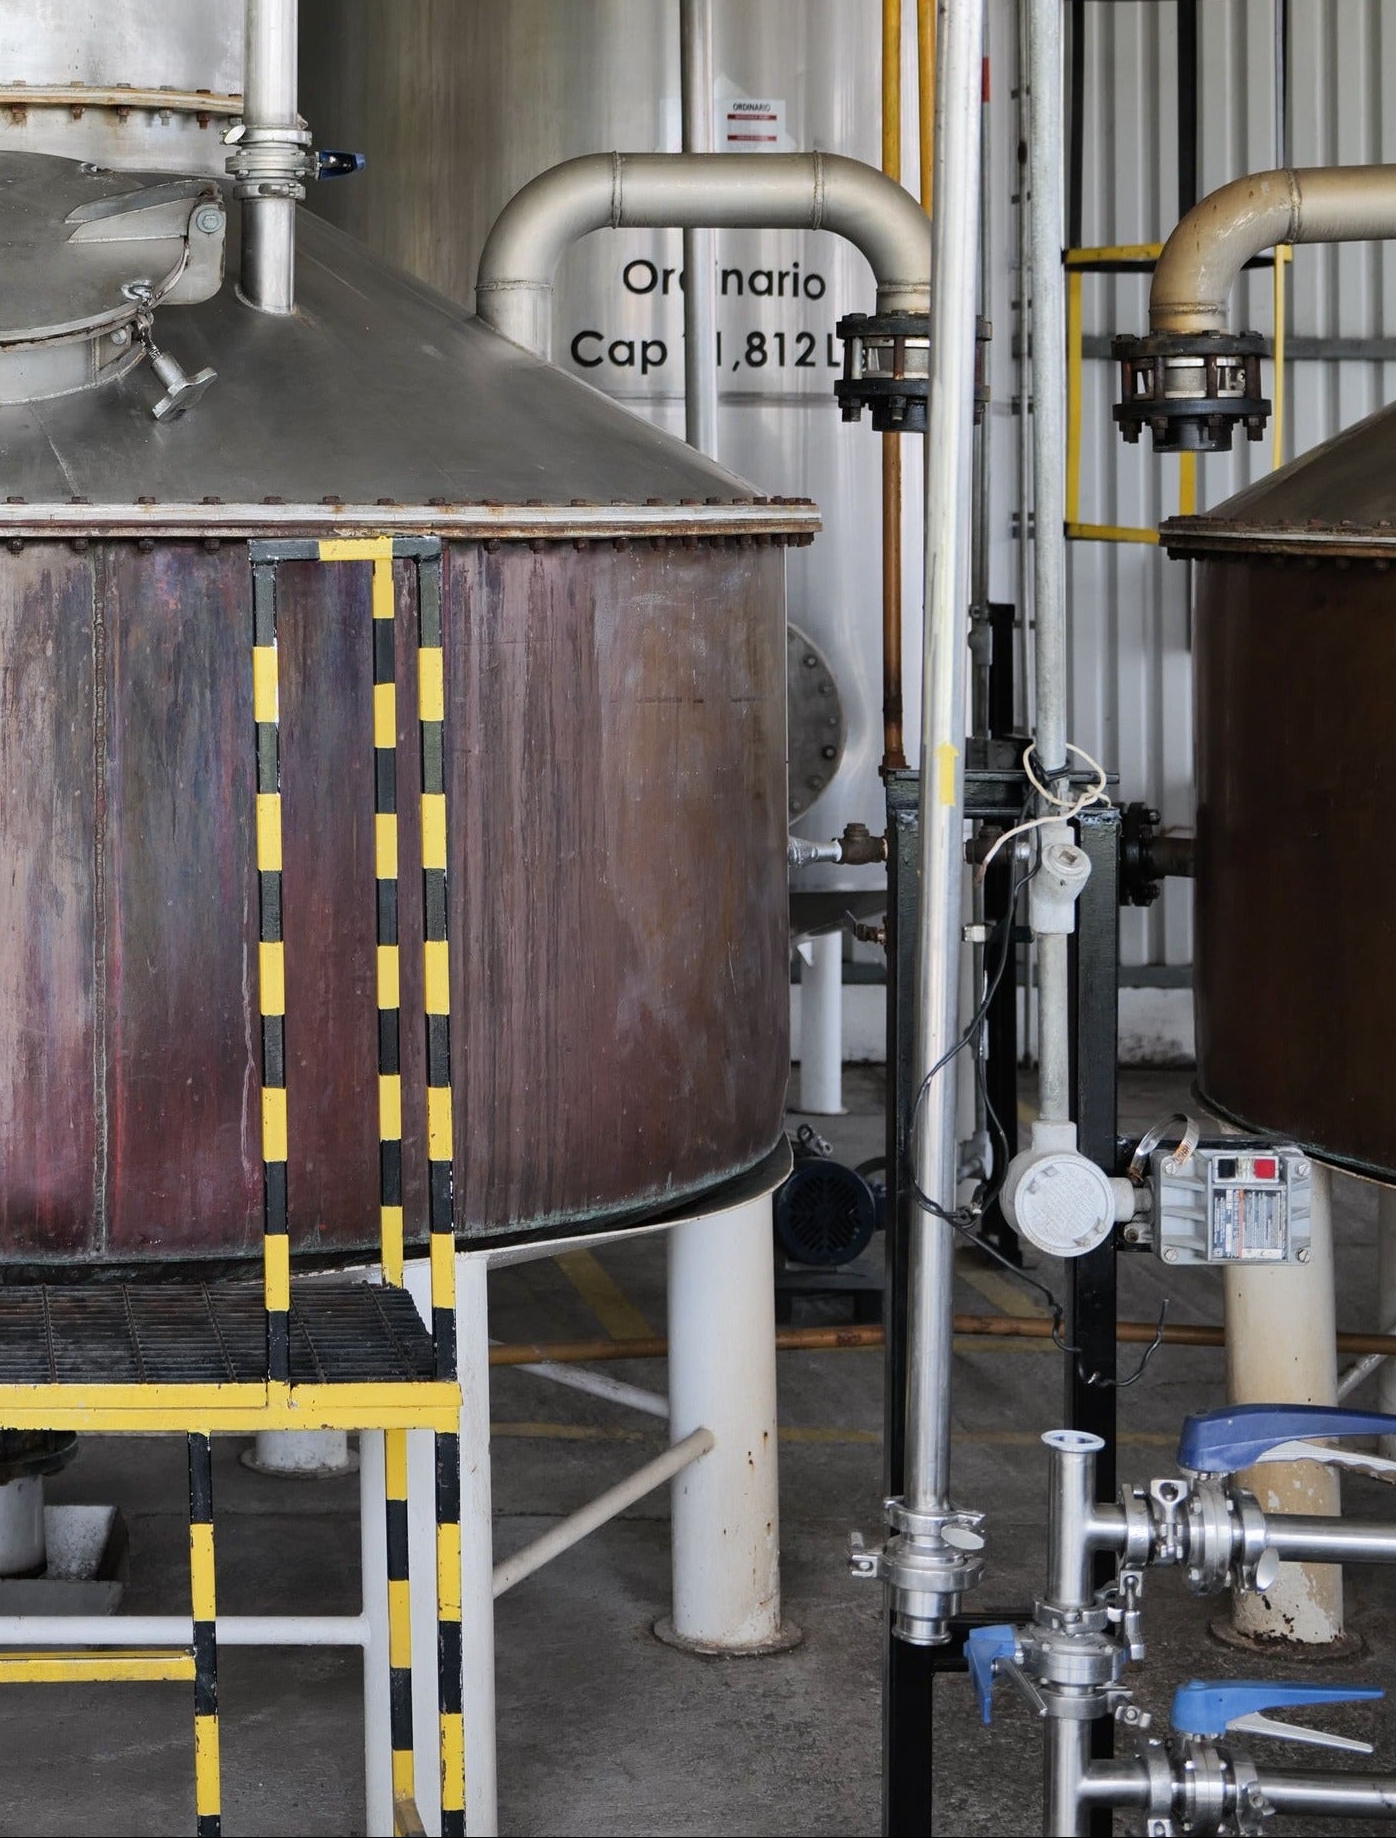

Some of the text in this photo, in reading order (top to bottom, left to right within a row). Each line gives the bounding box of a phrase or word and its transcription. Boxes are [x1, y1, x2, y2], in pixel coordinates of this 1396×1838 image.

[732, 102, 771, 113] ORDINARIO
[622, 259, 826, 301] Ornario
[570, 330, 668, 375] Cap
